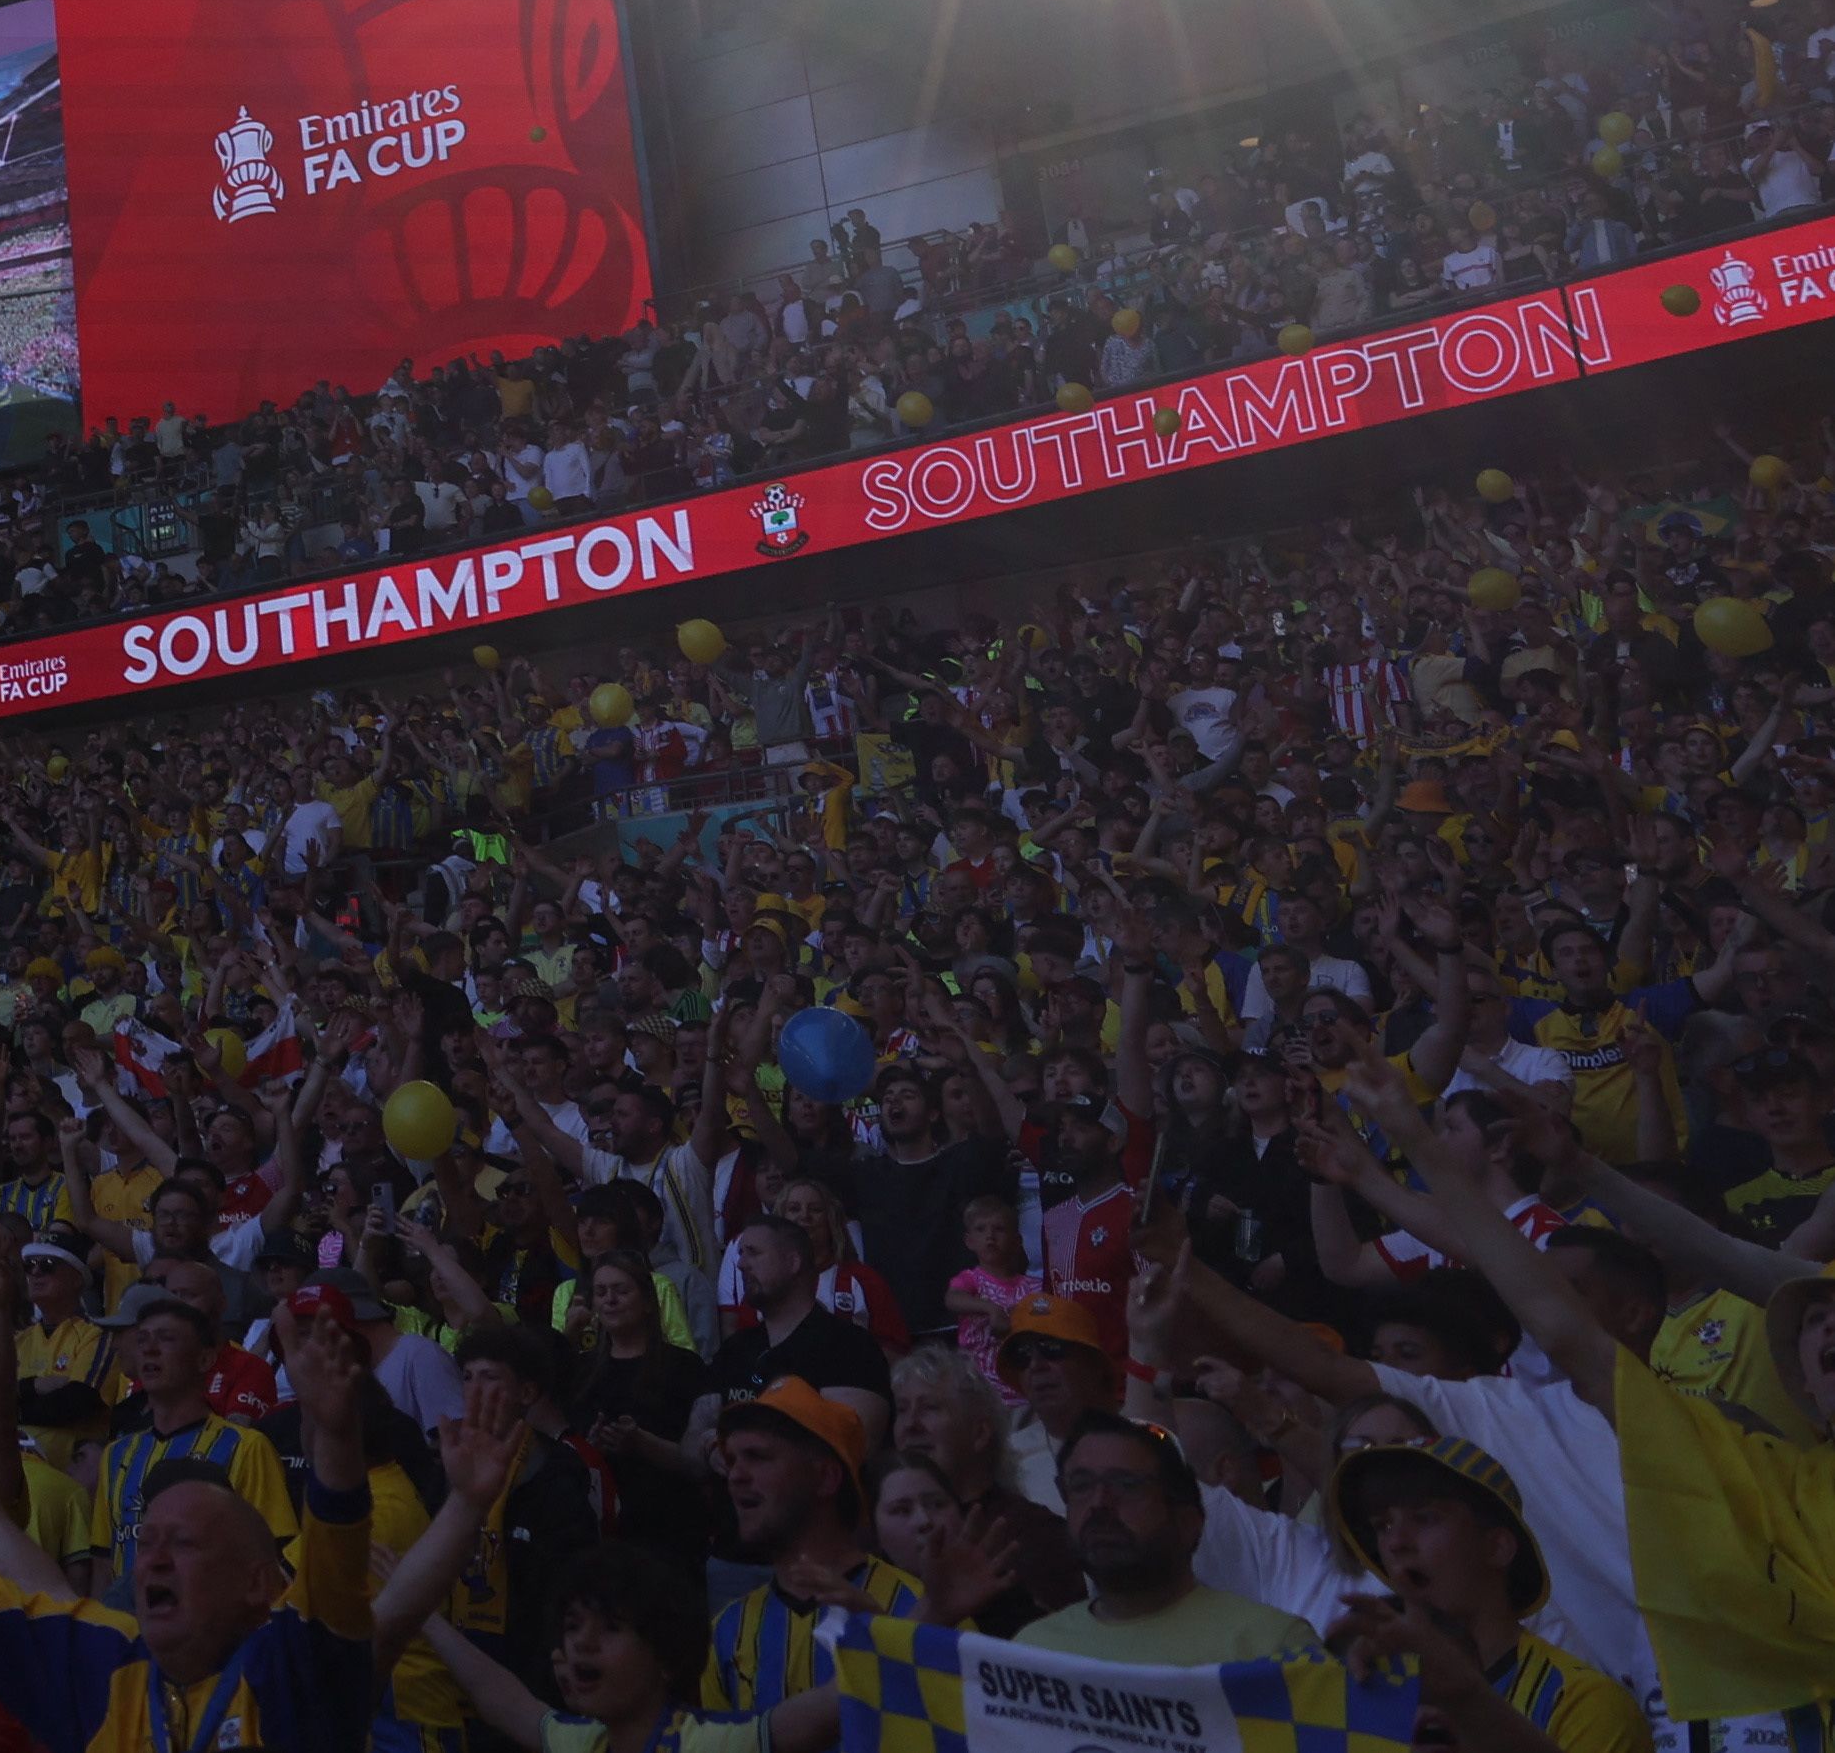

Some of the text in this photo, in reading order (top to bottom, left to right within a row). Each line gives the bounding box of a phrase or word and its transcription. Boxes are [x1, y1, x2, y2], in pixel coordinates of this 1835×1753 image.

[298, 84, 461, 150] Emirates
[304, 119, 466, 195] FA CUP
[1780, 276, 1826, 307] FA
[863, 288, 1612, 532] SOUTHAMPTON
[124, 510, 695, 685] SOUTHAMPTON
[0, 672, 68, 703] FA CUP
[979, 1660, 1202, 1738] SUPER SAINTS
[984, 1704, 1065, 1730] MARCHING
